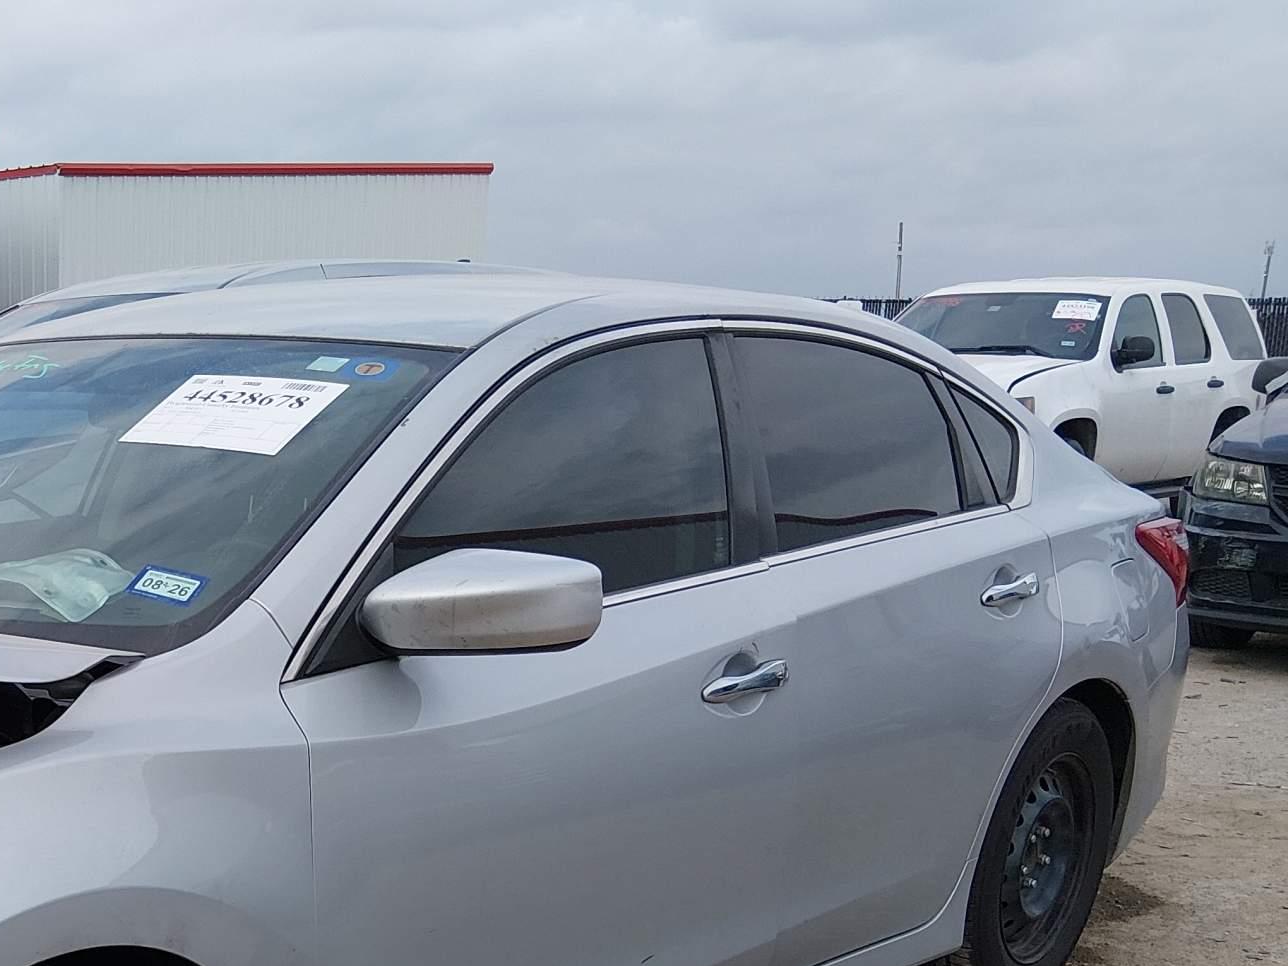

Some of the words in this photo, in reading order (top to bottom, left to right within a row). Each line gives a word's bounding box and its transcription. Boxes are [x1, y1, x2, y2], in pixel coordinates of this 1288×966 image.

[184, 389, 311, 410] 44528678
[143, 578, 164, 590] 08
[168, 584, 191, 597] 26
